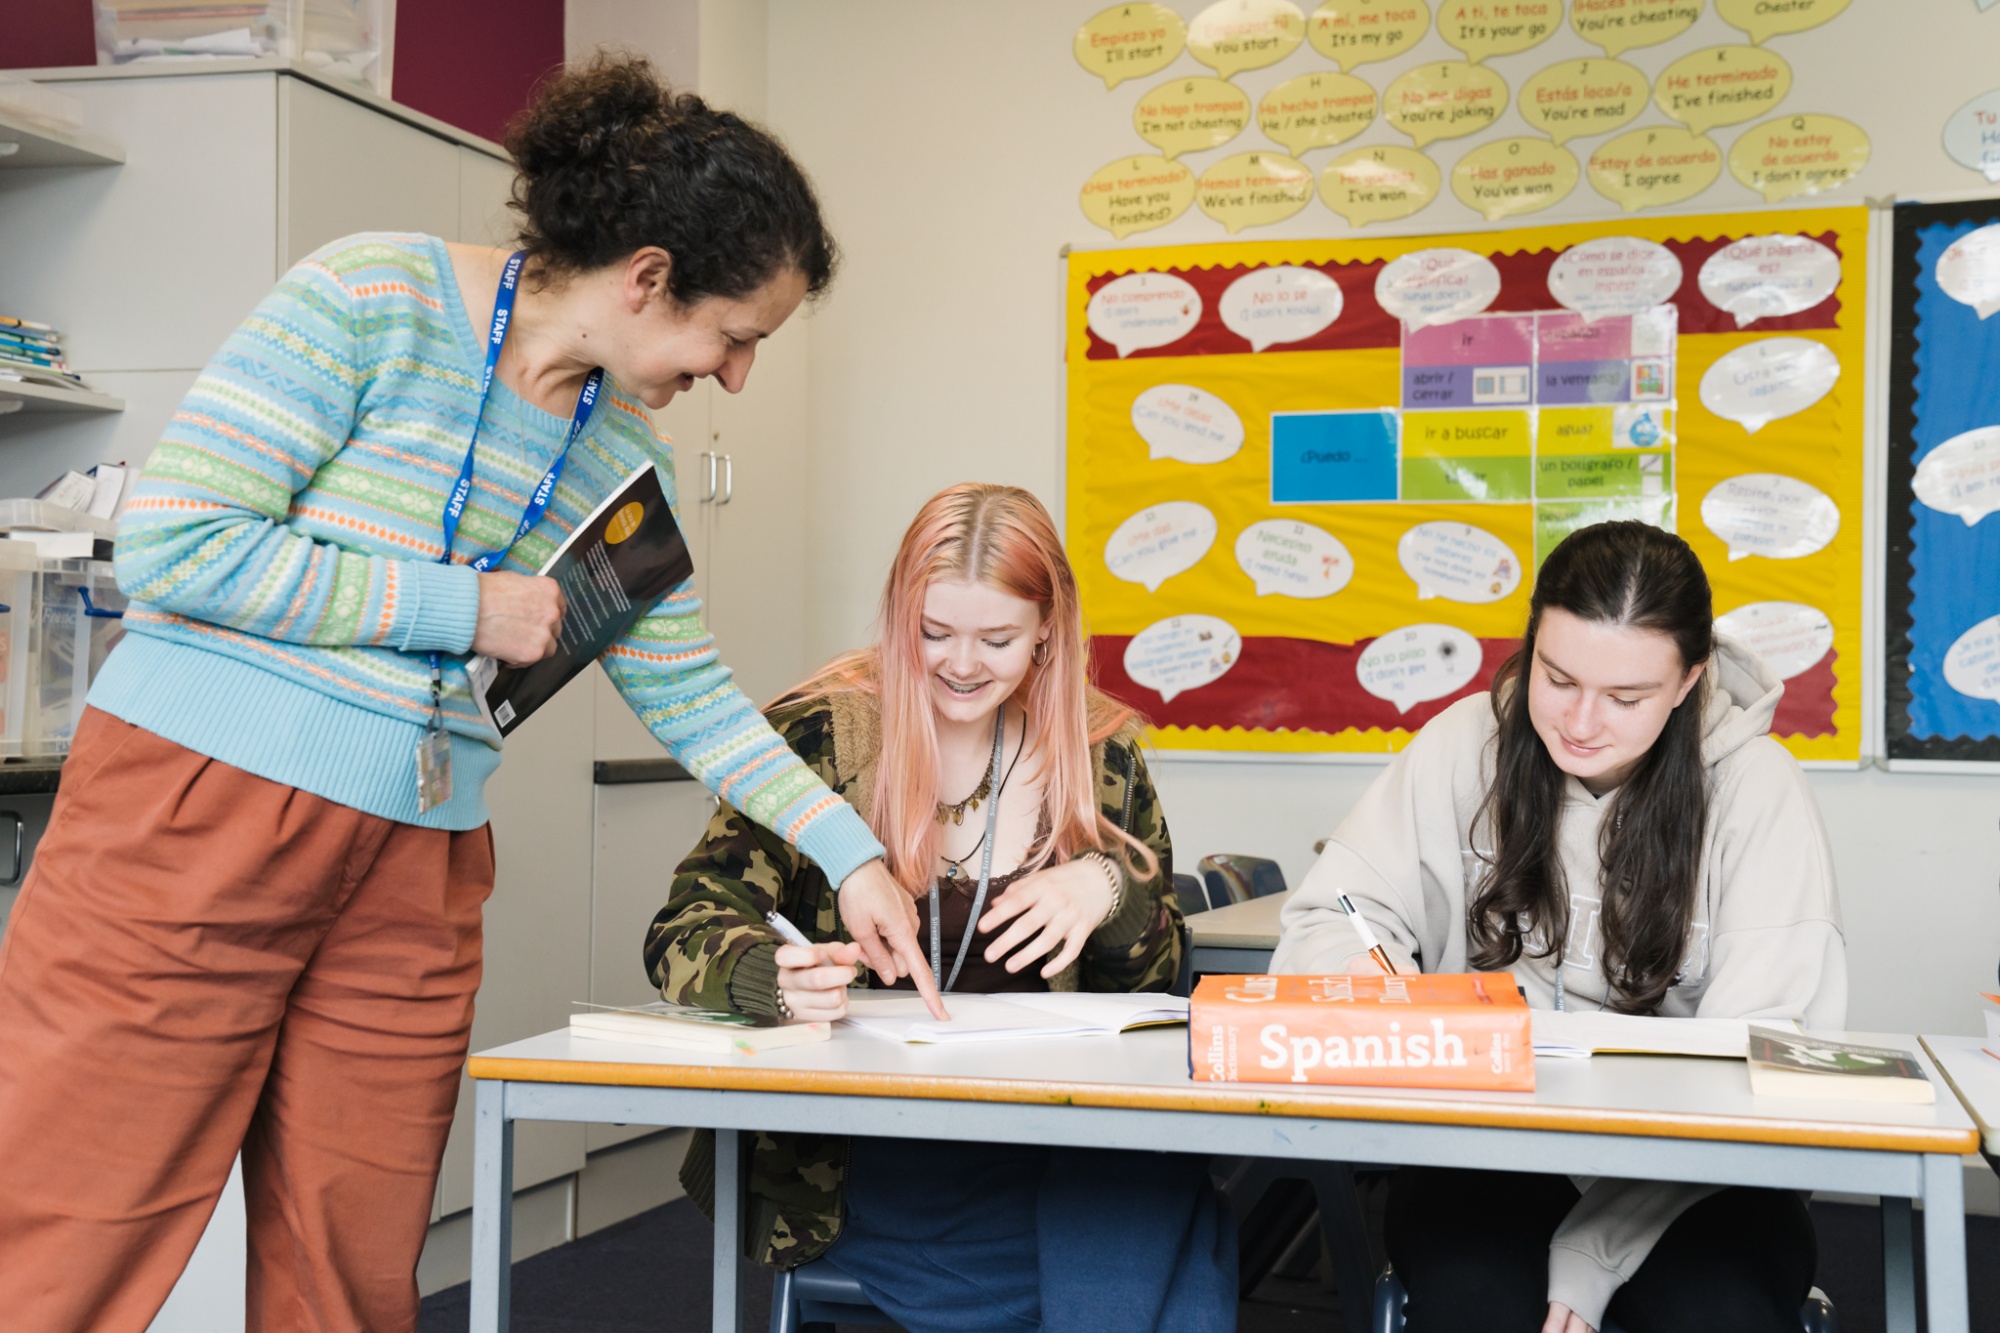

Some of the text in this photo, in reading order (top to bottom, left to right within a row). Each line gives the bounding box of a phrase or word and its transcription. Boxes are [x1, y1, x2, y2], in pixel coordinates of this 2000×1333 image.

[1123, 8, 1130, 17] A
[1456, 8, 1465, 20] A
[1493, 5, 1510, 18] te
[1514, 2, 1548, 16] toca
[1754, 0, 1815, 16] Cheater
[1319, 19, 1328, 29] A
[1358, 14, 1379, 26] me
[1384, 8, 1417, 23] toca
[1577, 7, 1698, 32] You're cheating
[1090, 27, 1167, 48] Empiezo yo
[1331, 30, 1403, 47] It's my go
[1460, 23, 1546, 41] It's your go
[1106, 45, 1163, 63] I'll start
[1213, 37, 1279, 54] You start
[1717, 51, 1727, 62] K
[1667, 65, 1779, 89] He terminado
[1402, 86, 1492, 105] No me digas
[1584, 82, 1632, 99] loco/a
[1673, 85, 1774, 109] I've finished
[1140, 98, 1244, 119] No hago trampas
[1280, 99, 1318, 113] hecho
[1322, 93, 1375, 110] trampas
[1262, 108, 1373, 132] He she cheated
[1401, 105, 1495, 124] You're joking
[1542, 104, 1625, 121] You're mad
[1142, 116, 1242, 134] I'm not cheating
[1792, 116, 1805, 130] Q
[1769, 134, 1832, 149] No estoy
[1374, 151, 1385, 162] N
[1635, 154, 1654, 167] de
[1656, 150, 1717, 167] acuerdo
[1762, 149, 1839, 167] de acuerdo
[1118, 169, 1188, 191] terminado?
[1471, 162, 1555, 181] Has ganado
[1637, 171, 1681, 190] agree
[1765, 168, 1801, 183] don't
[1805, 166, 1847, 184] agree
[1199, 176, 1242, 191] Hemos
[1473, 182, 1553, 198] You've won
[1108, 192, 1171, 209] Have you
[1203, 187, 1308, 210] We've finished
[1348, 188, 1407, 203] I've won
[1110, 206, 1172, 227] finished?
[503, 258, 521, 290] STAFF
[1121, 289, 1185, 303] comprendo
[1252, 291, 1273, 305] No
[491, 309, 508, 345] STAFF
[1462, 332, 1474, 346] ir
[1413, 371, 1444, 385] abrir
[1546, 374, 1557, 386] la
[1413, 388, 1454, 401] cerrar
[1425, 425, 1509, 440] ir a buscar
[1556, 424, 1593, 437] agua?
[1301, 450, 1351, 464] ¿Puedo
[1539, 461, 1557, 472] un
[534, 472, 556, 506] STAFF
[1567, 475, 1605, 489] papel
[449, 479, 470, 518] STAFF
[1361, 656, 1380, 669] No
[1376, 667, 1405, 680] don't
[985, 833, 993, 851] Form
[982, 852, 990, 871] Sixth
[932, 952, 940, 972] Sixth
[1208, 1025, 1225, 1081] Collins
[1260, 1019, 1467, 1082] Spanish
[1490, 1032, 1502, 1074] Collins
